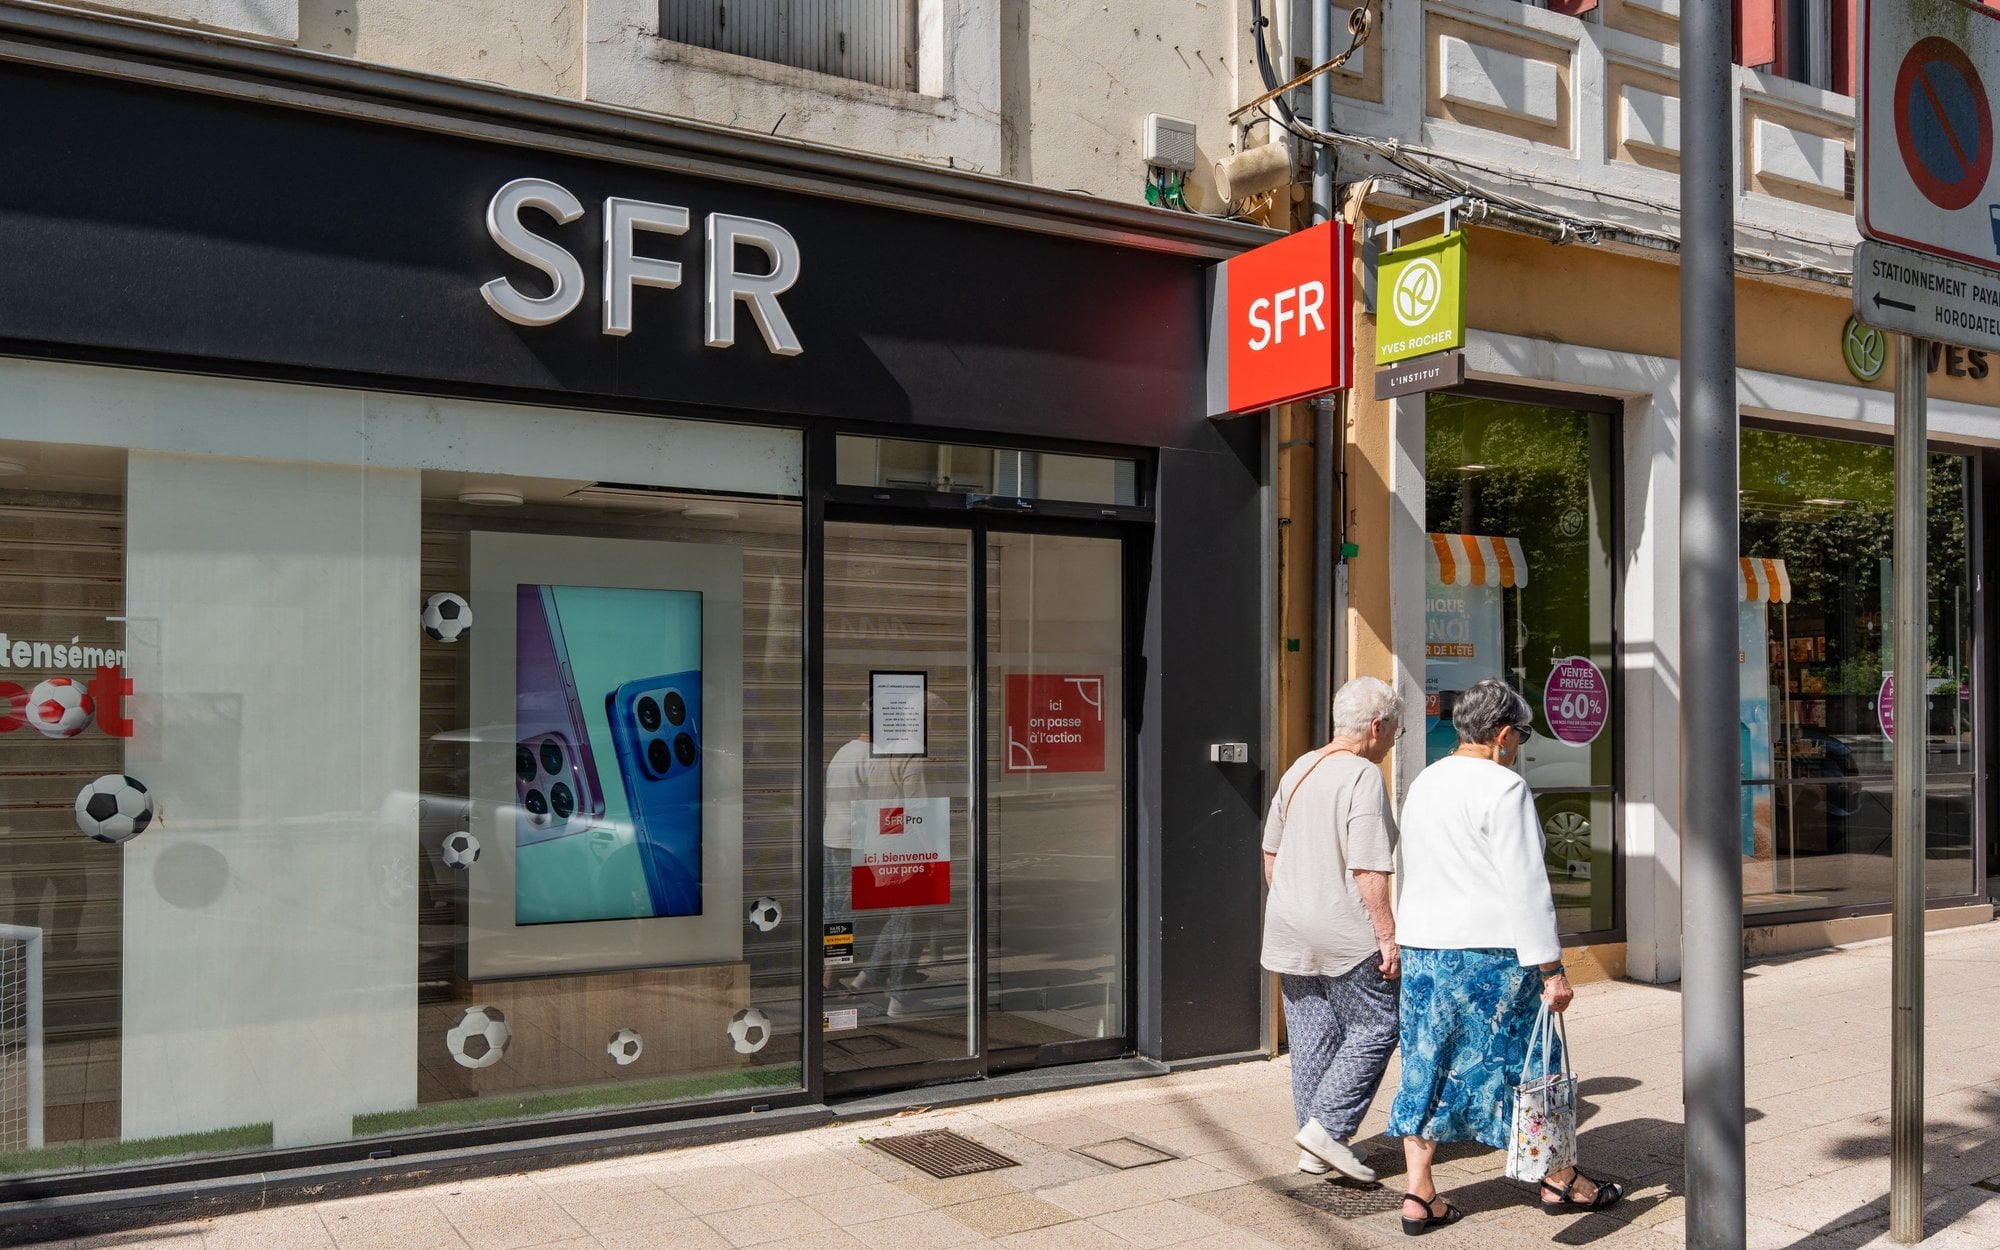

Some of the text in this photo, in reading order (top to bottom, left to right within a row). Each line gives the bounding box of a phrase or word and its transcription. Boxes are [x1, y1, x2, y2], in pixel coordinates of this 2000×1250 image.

[479, 177, 804, 357] SFR
[1872, 259, 2000, 309] STATIONNEMENT PAYA
[1248, 280, 1326, 351] SFR
[1381, 329, 1452, 356] YVES ROCHER
[1927, 341, 1989, 379] VES
[1390, 367, 1440, 387] L'INSTITUT
[1426, 613, 1470, 641] NOÏ
[1433, 644, 1447, 655] DE
[1561, 667, 1594, 678] VENTES
[1559, 677, 1594, 689] PRIVÉES
[1049, 699, 1062, 711] ici
[1552, 693, 1601, 719] -60%
[1029, 718, 1081, 731] on passe
[1029, 731, 1081, 743] à l'action
[884, 815, 923, 826] SFR Pro
[864, 850, 938, 865] ici, bienvenue
[878, 864, 925, 877] aux pros
